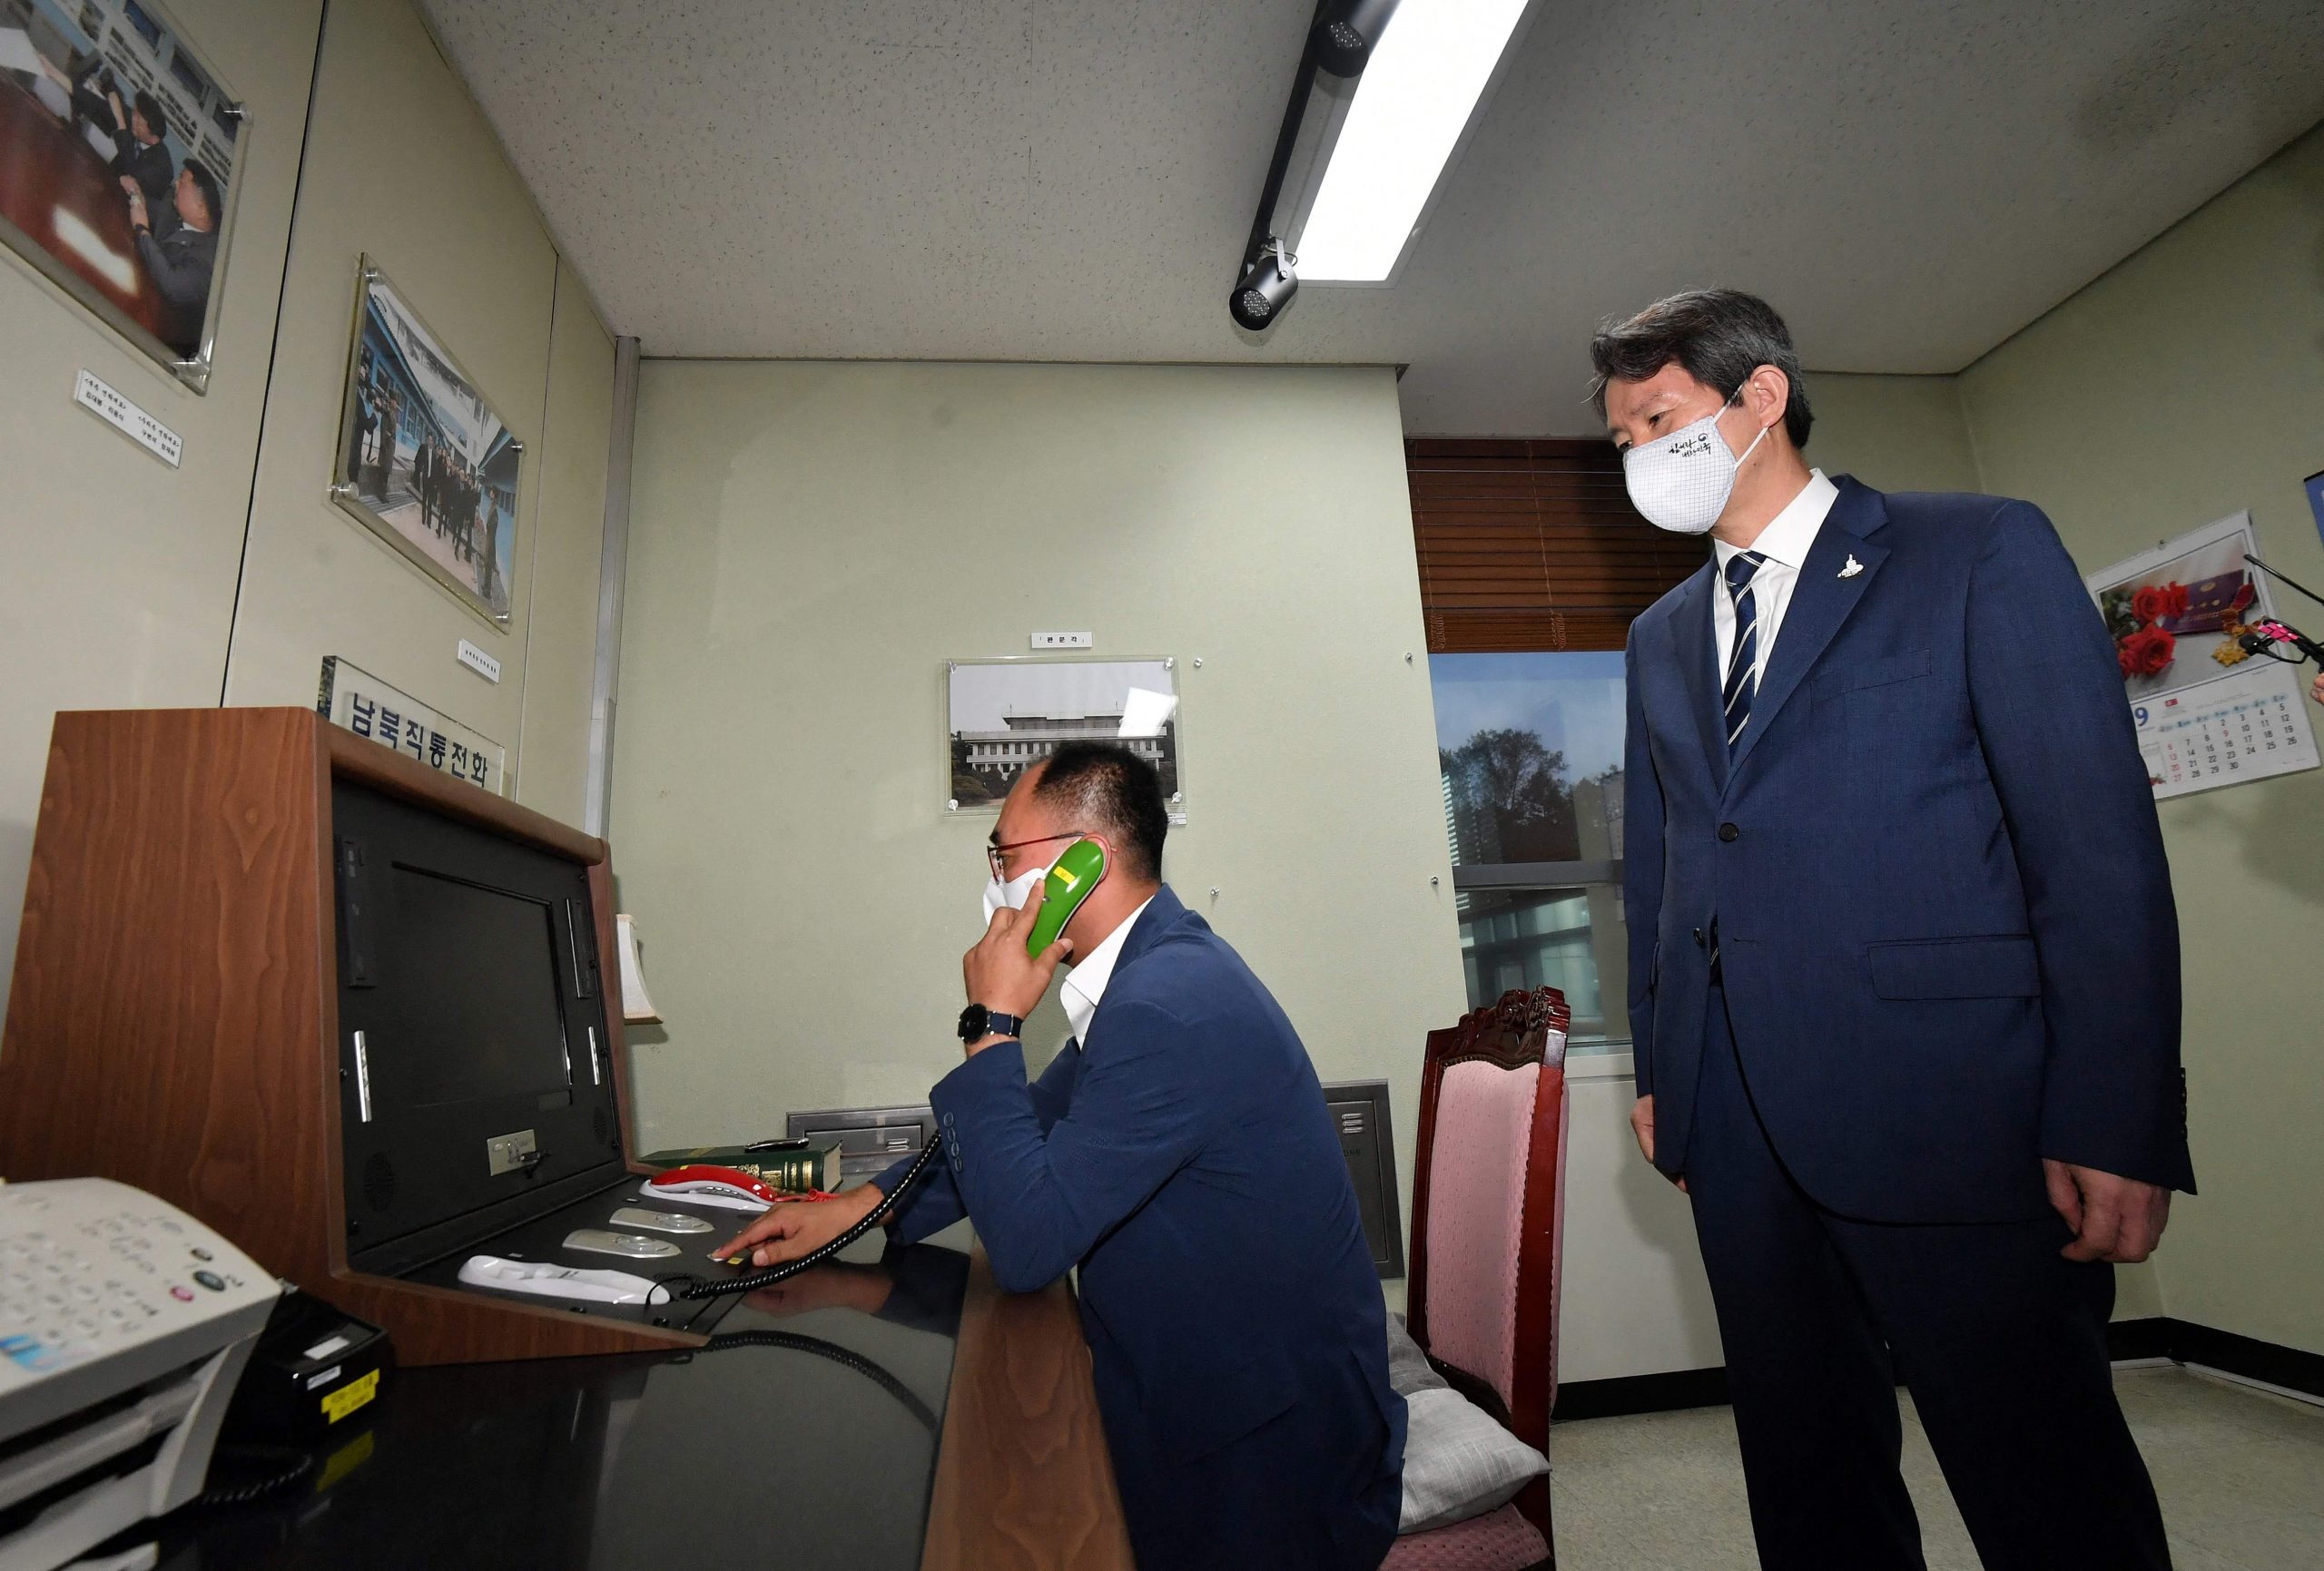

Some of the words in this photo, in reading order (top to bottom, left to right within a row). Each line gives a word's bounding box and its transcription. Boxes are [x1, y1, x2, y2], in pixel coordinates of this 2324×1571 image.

[1669, 438, 1697, 454] 힘내라
[1681, 442, 1711, 458] 대한민국
[2134, 707, 2149, 727] 9
[2221, 718, 2225, 726] 2
[2240, 713, 2245, 722] 3
[2284, 725, 2293, 733] 19
[352, 692, 487, 788] 남북직통전화
[2185, 738, 2191, 746] 7
[2227, 751, 2236, 759] 23
[2267, 741, 2276, 750] 25
